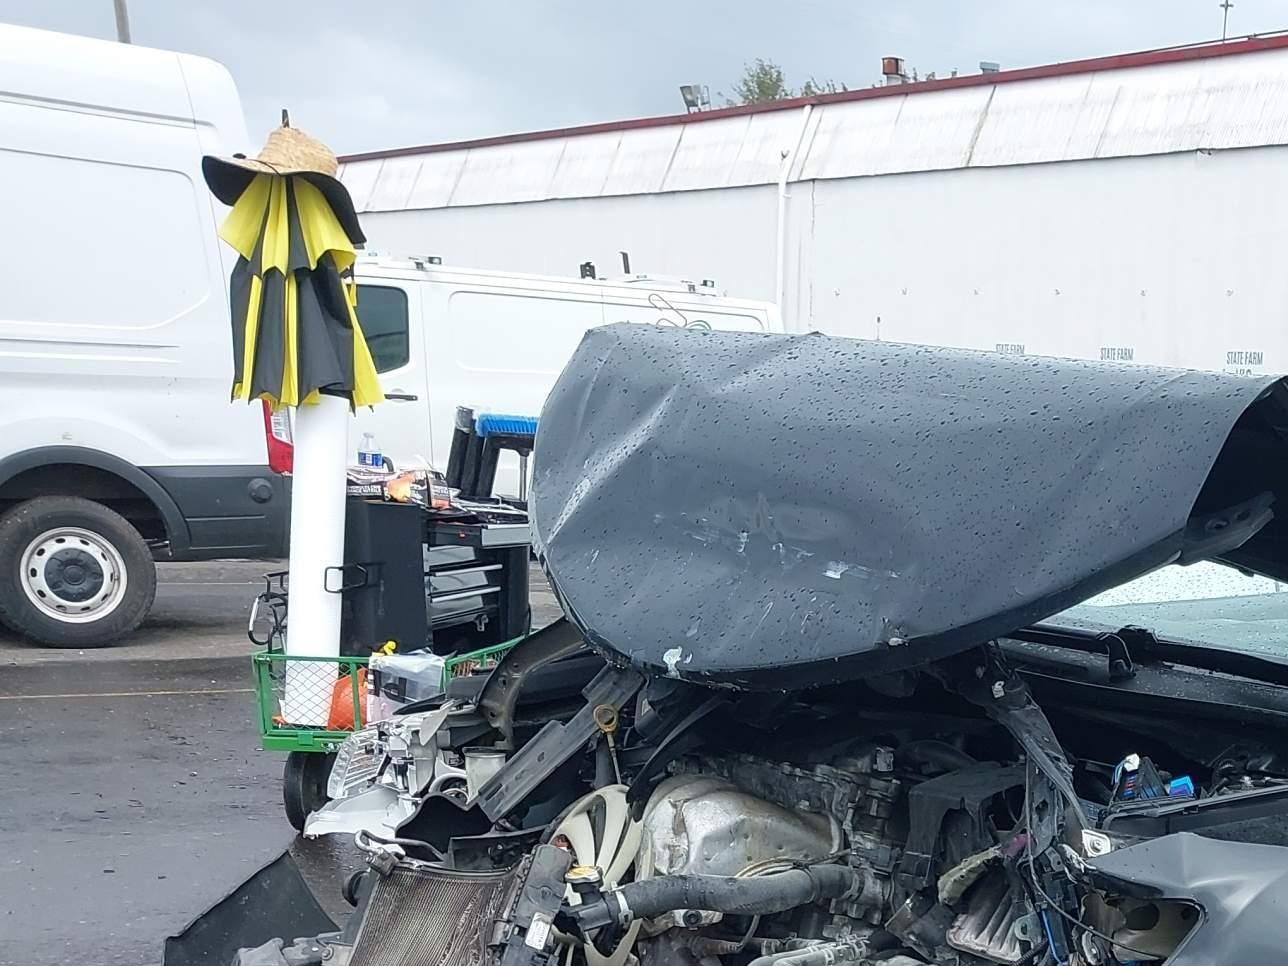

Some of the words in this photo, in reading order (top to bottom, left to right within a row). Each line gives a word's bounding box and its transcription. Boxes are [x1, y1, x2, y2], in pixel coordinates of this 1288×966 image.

[1100, 347, 1116, 361] STATE
[1116, 347, 1134, 361] FARM
[1226, 351, 1244, 365] STATE
[1244, 351, 1263, 366] FARM
